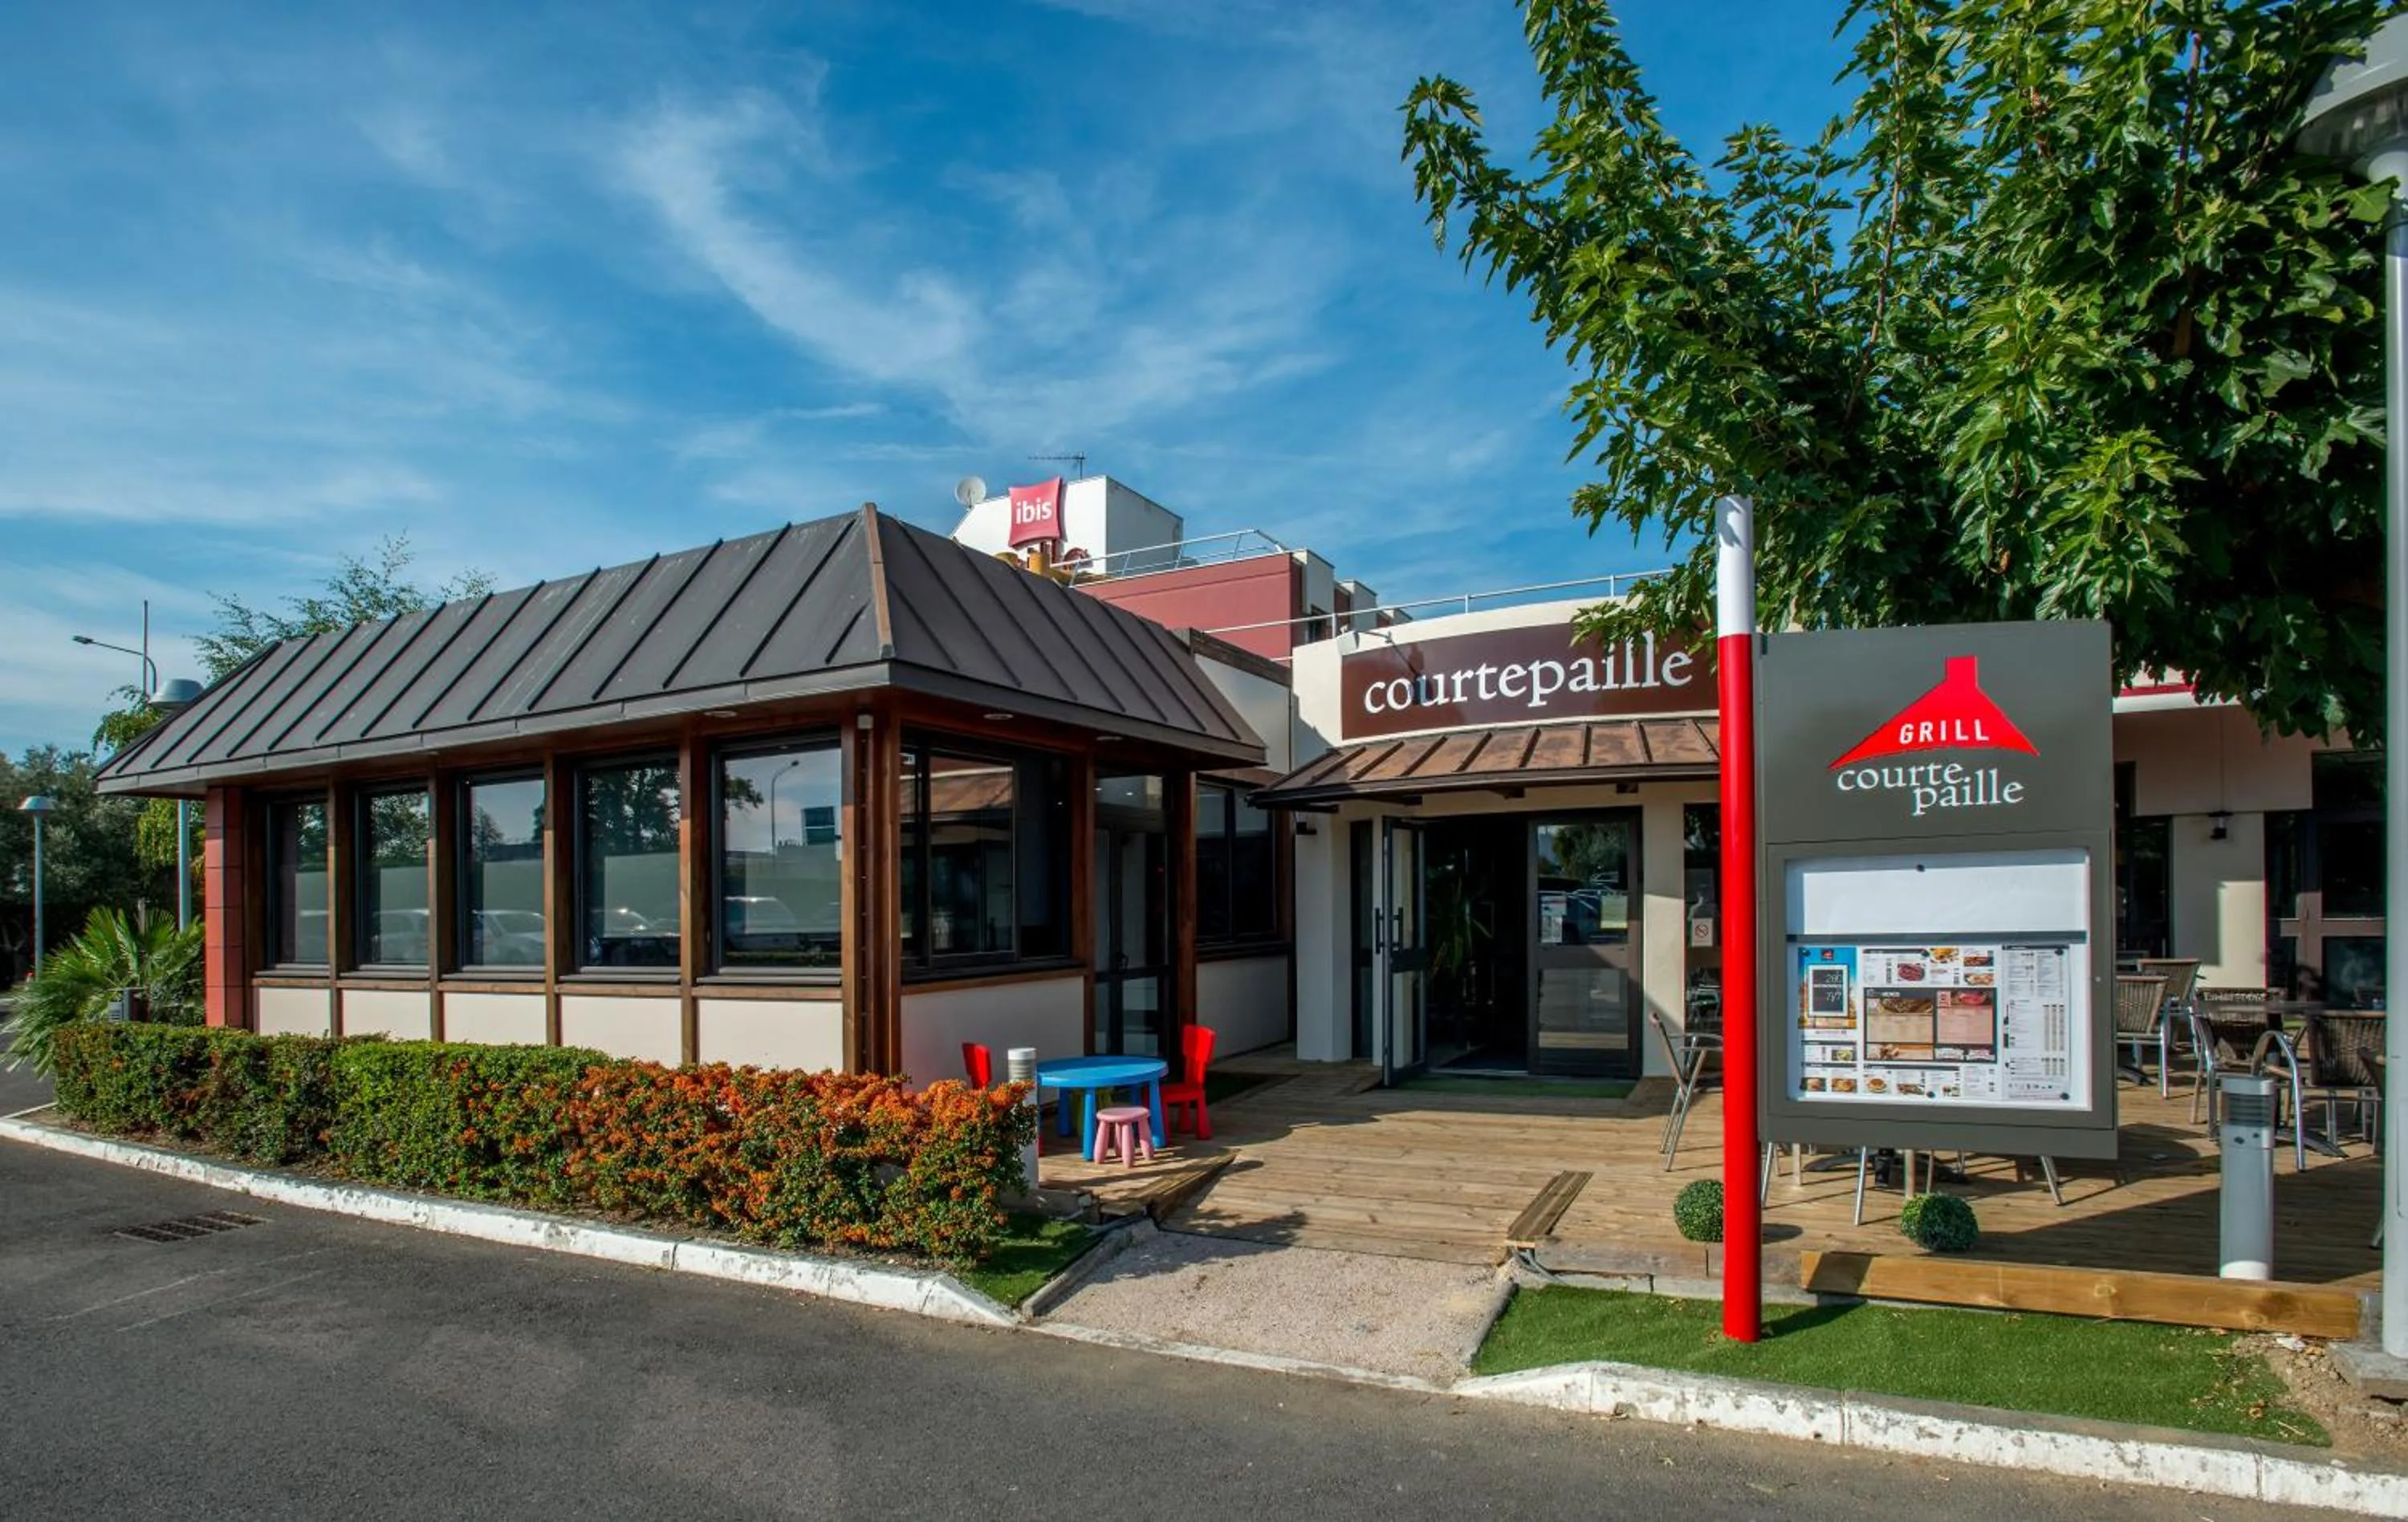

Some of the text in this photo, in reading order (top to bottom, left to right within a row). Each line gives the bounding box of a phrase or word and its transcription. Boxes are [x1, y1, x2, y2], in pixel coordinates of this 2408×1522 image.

[1015, 496, 1053, 524] ibis
[1364, 629, 1693, 714] courtepaille
[1899, 718, 1990, 745] GRILL
[1837, 762, 1964, 792] courte
[1912, 767, 2025, 816] paille
